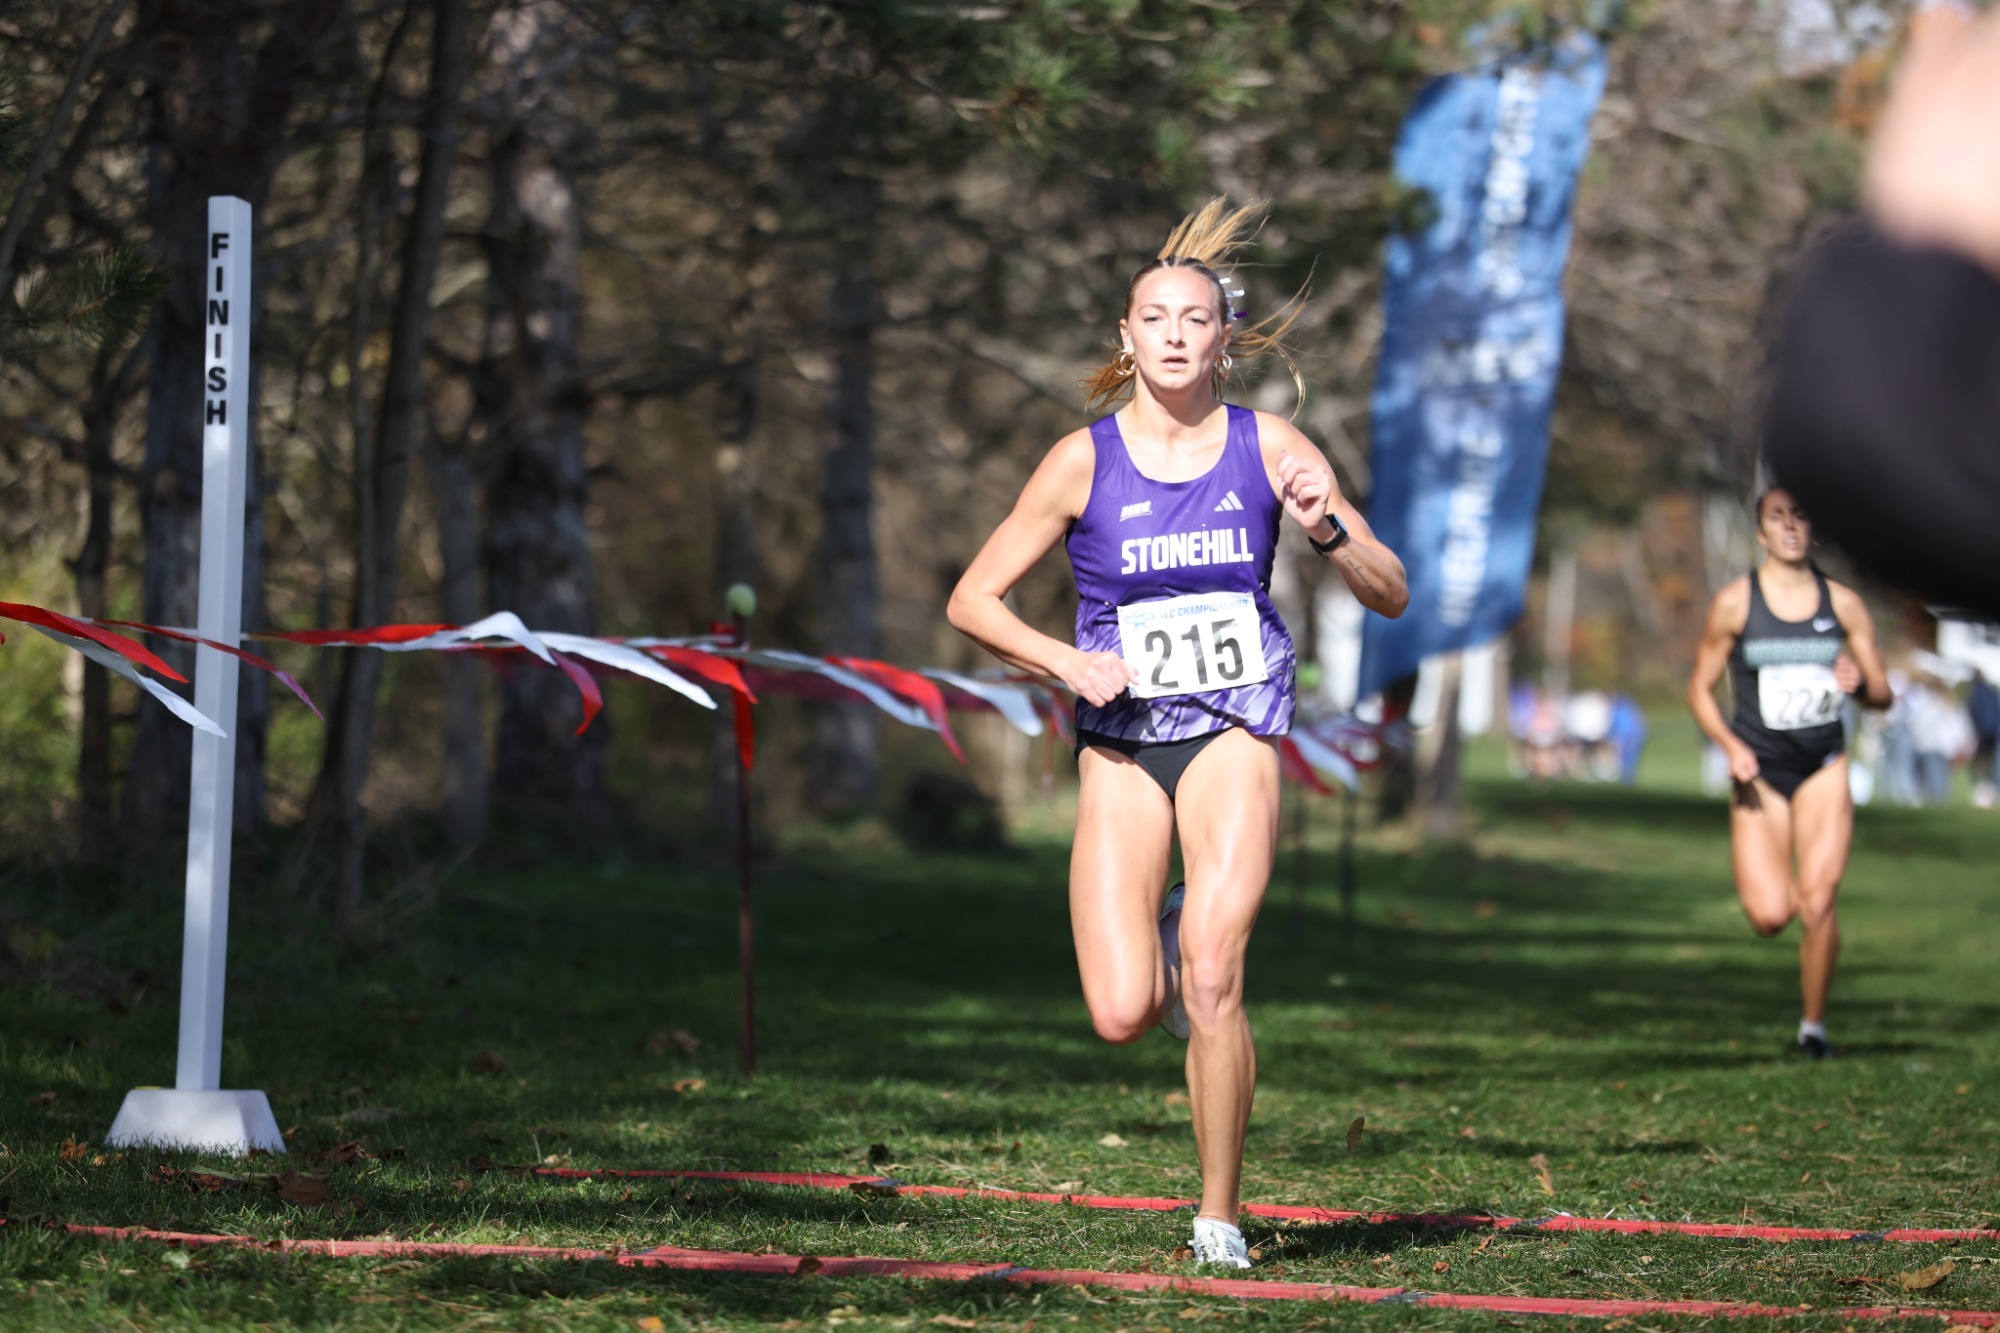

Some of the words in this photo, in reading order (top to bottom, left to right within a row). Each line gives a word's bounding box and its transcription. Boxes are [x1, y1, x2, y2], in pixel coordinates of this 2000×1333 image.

[205, 232, 230, 426] FINISH
[1121, 528, 1254, 575] STONEHILL
[1144, 618, 1244, 693] 215
